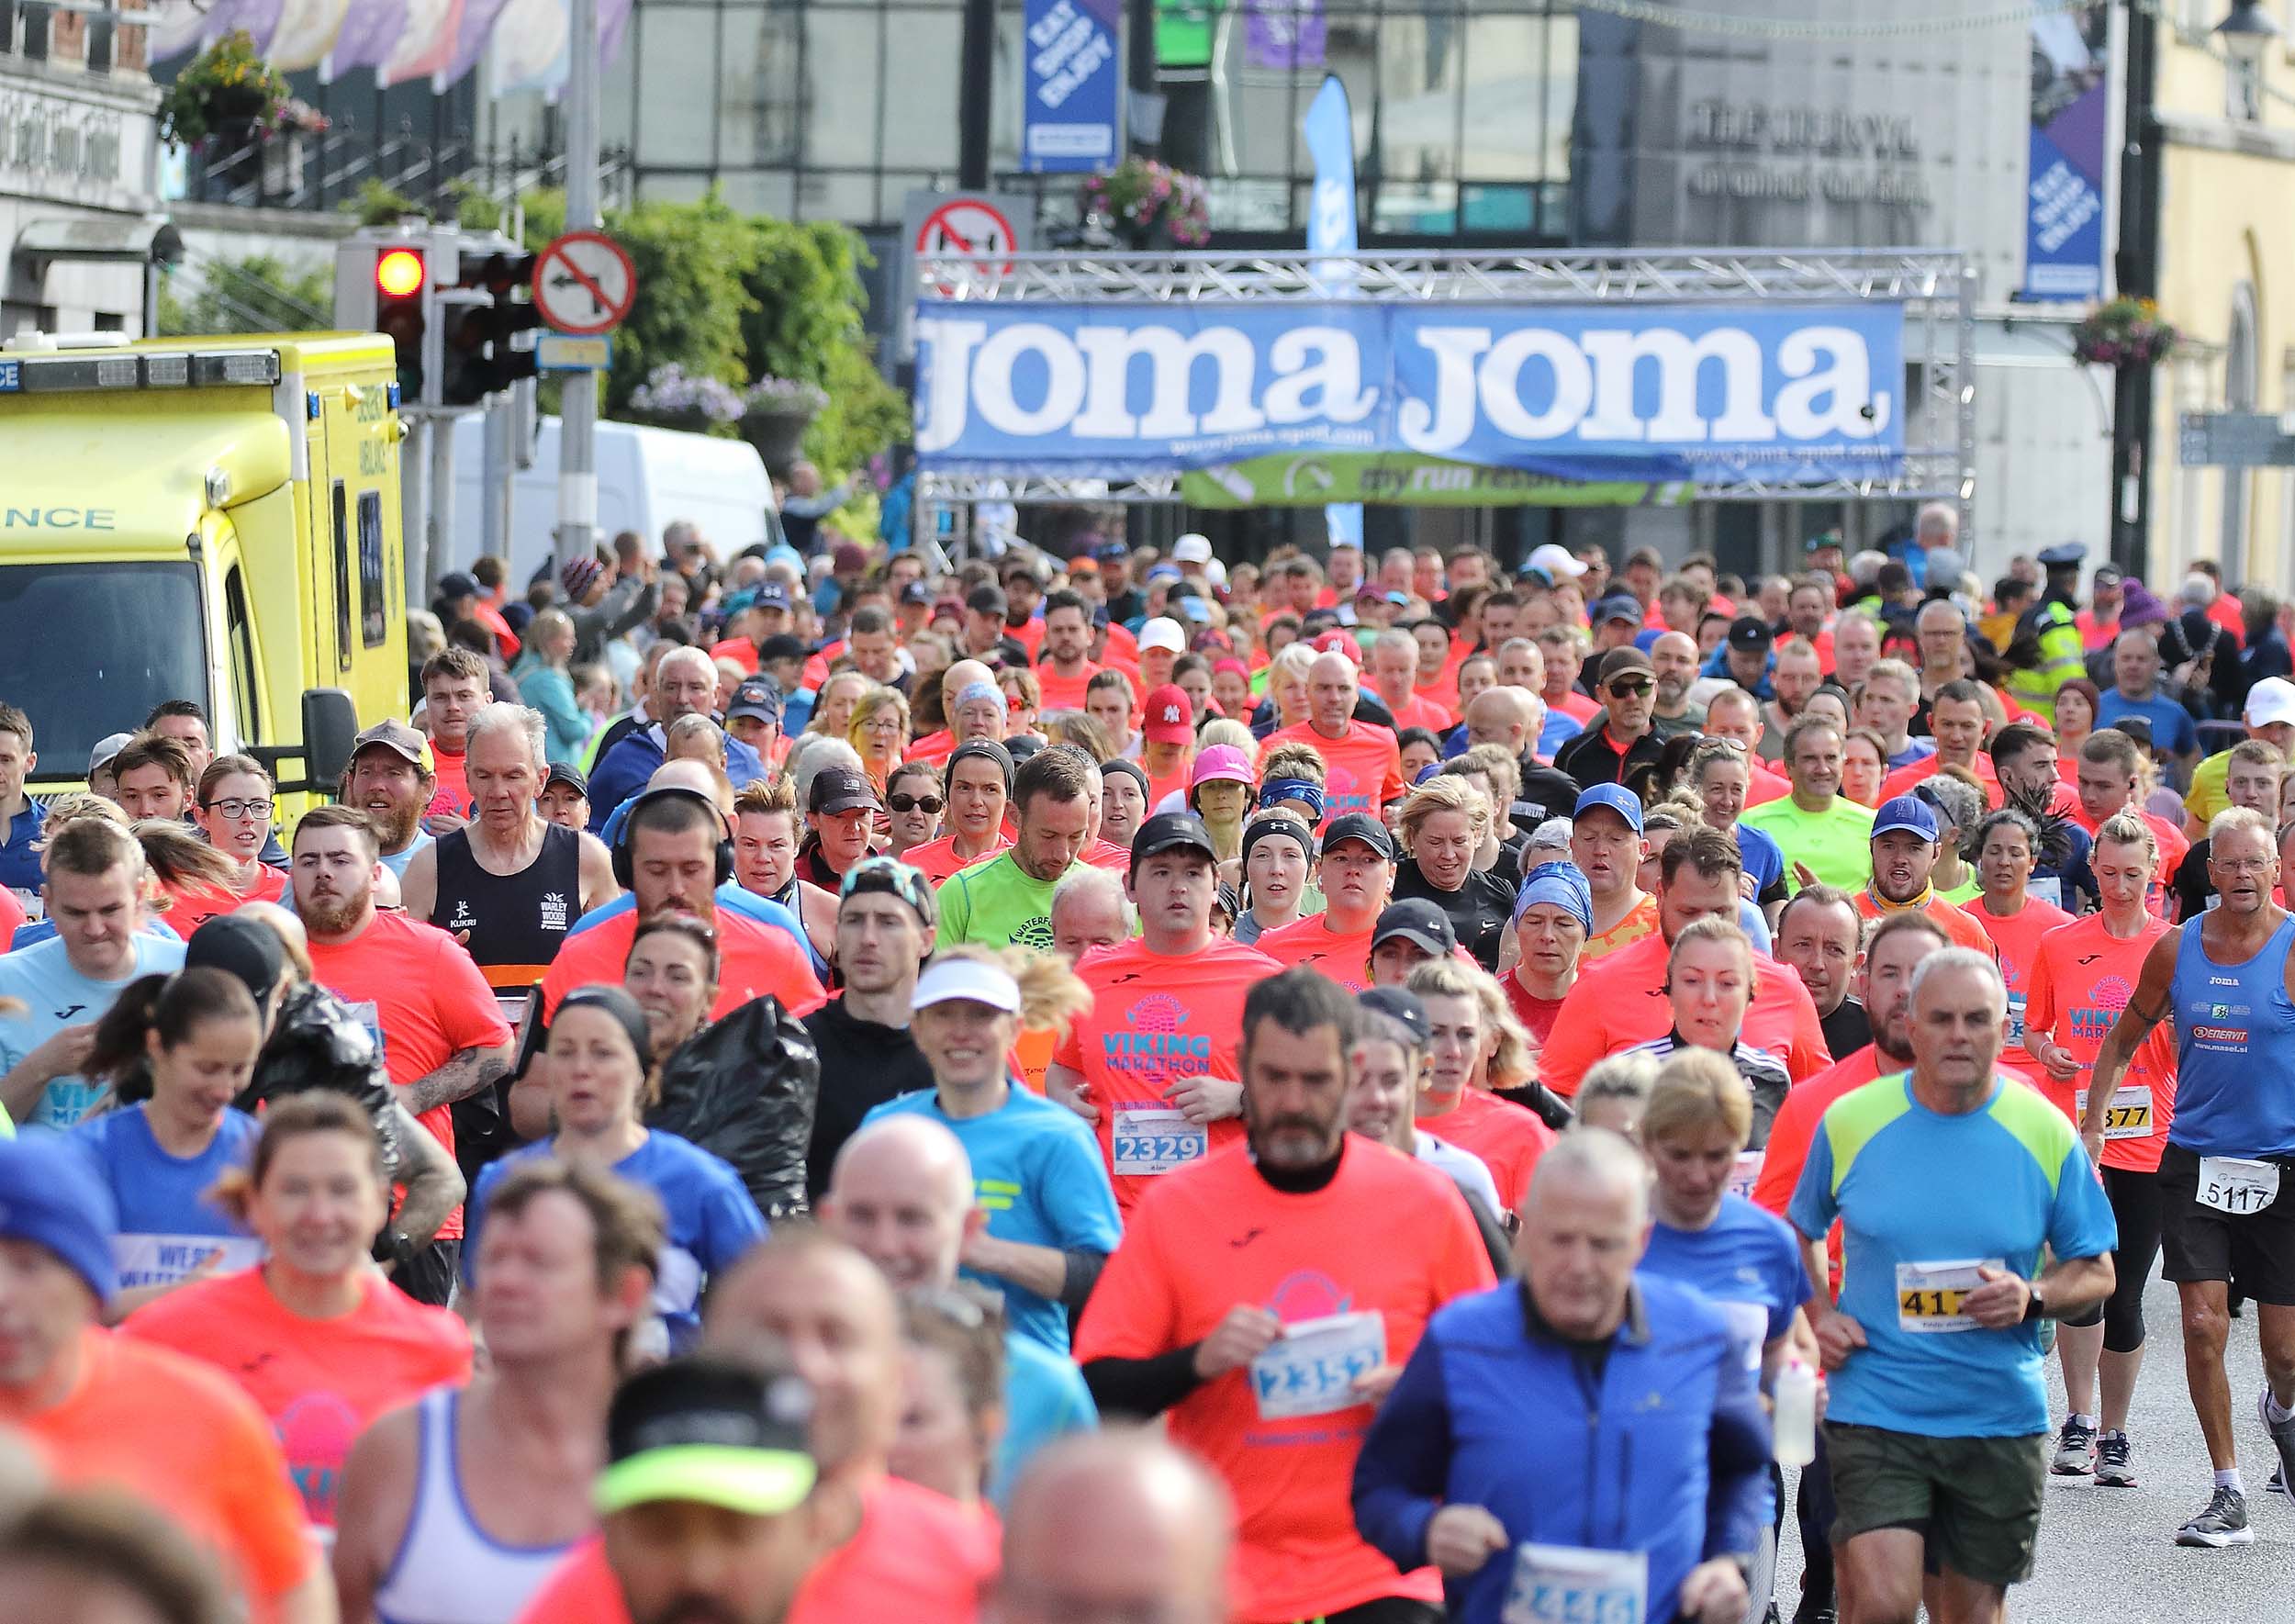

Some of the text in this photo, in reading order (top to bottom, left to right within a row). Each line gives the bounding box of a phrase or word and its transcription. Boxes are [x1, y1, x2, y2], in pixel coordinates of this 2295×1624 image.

[0, 508, 116, 530] NCE
[541, 902, 568, 913] WARLEY
[542, 911, 566, 922] WOODS
[450, 919, 477, 929] KUKRI
[1015, 916, 1052, 937] WATERF
[2068, 1008, 2121, 1027] VIKI
[1103, 1032, 1211, 1058] VIKING
[2207, 1028, 2247, 1041] ENERVIT
[1106, 1057, 1211, 1073] MARATHON
[48, 1084, 106, 1108] VIK
[1120, 1137, 1199, 1161] 2329
[2207, 1182, 2269, 1211] 5117
[1904, 1291, 1970, 1316] 417
